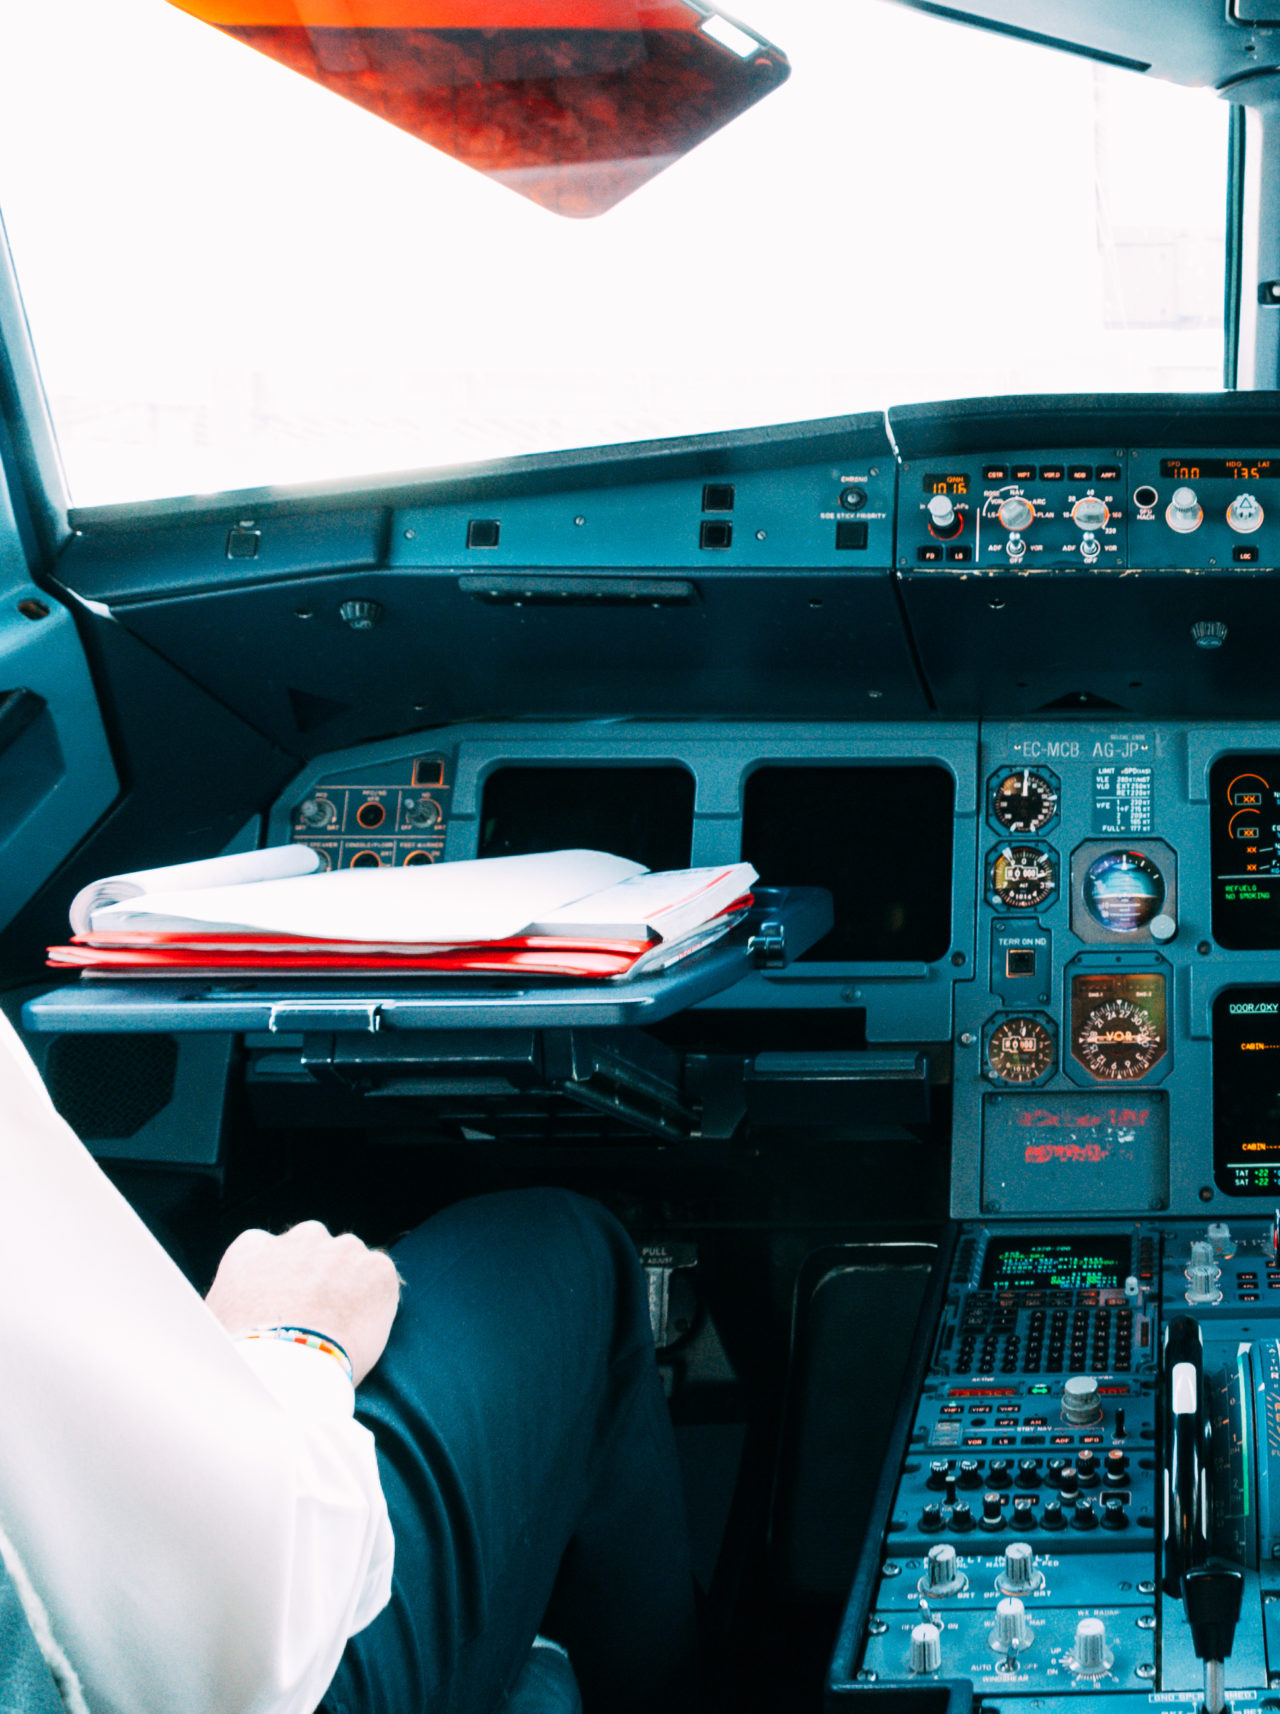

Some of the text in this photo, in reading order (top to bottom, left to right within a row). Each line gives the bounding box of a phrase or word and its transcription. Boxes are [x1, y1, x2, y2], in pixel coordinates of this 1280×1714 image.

[1023, 742, 1139, 757] EC-MCB AG-JP
[1106, 1031, 1132, 1040] VOR
